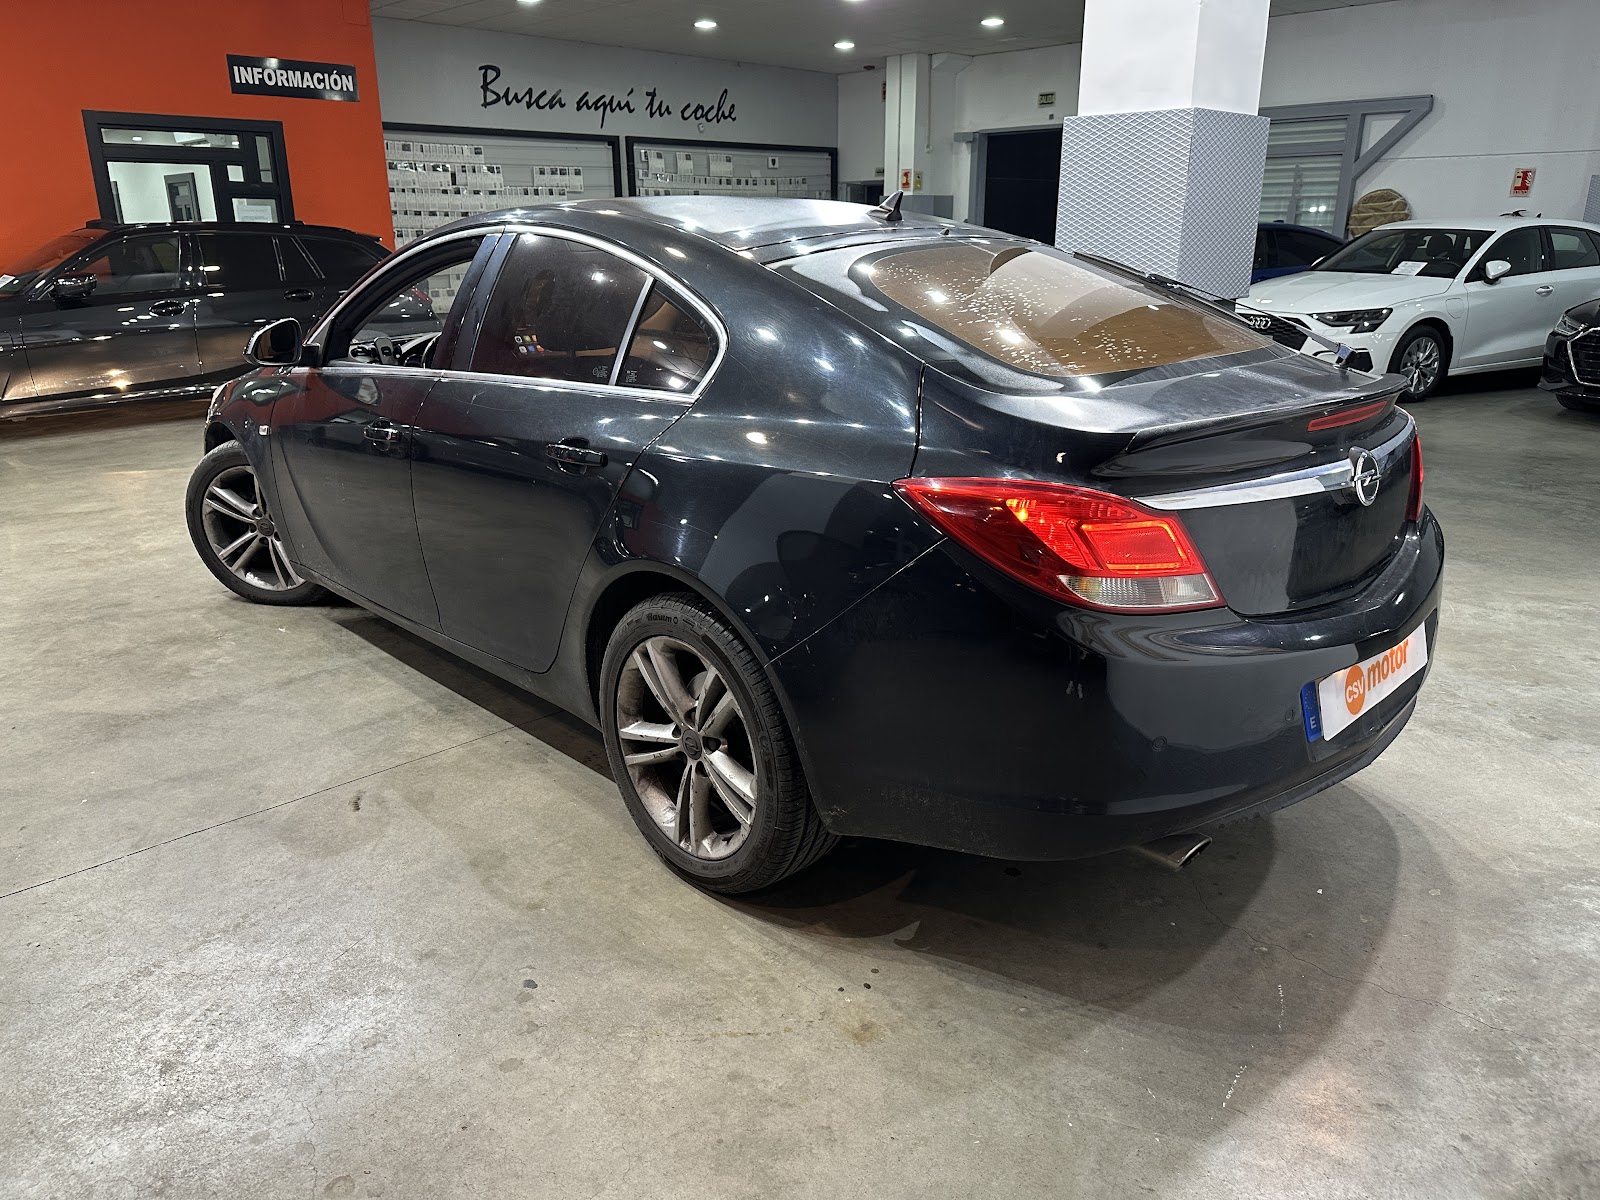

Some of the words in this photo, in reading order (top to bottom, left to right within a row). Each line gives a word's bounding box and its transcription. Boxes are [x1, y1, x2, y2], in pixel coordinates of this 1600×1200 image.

[233, 65, 354, 92] INFORMACIÓN
[478, 64, 566, 109] Busca
[576, 88, 635, 129] aquí
[645, 87, 672, 118] tu
[680, 88, 737, 123] coche
[1366, 638, 1409, 692] motor
[1309, 715, 1317, 730] E
